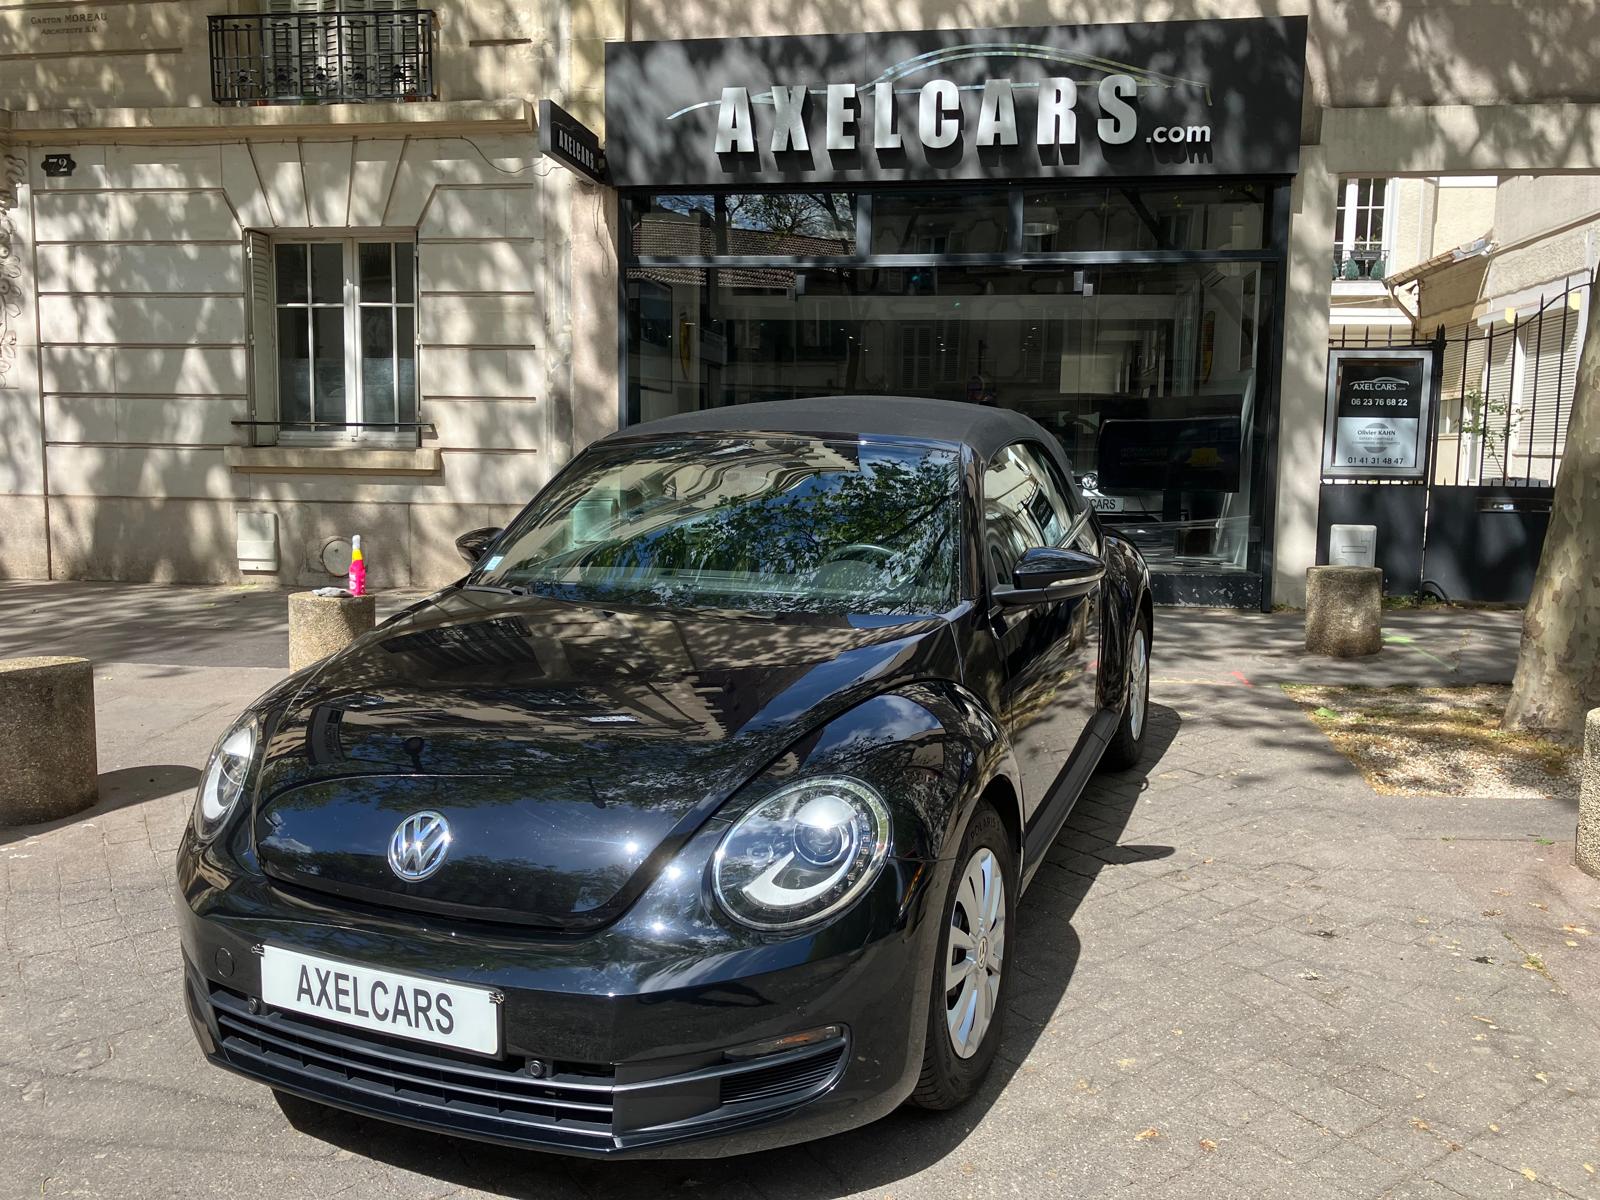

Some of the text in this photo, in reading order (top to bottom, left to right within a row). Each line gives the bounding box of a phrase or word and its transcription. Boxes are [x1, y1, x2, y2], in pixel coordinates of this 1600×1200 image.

[64, 12, 108, 22] MOREAU
[714, 74, 1211, 153] AXELCARS .com
[558, 129, 594, 170] AXELCARS
[48, 157, 68, 172] 72
[1351, 398, 1408, 406] 06 23 76 68 22
[1347, 456, 1357, 464] 01
[1382, 457, 1392, 465] 48
[1393, 457, 1404, 465] 47
[296, 964, 454, 1035] AXELCARS
